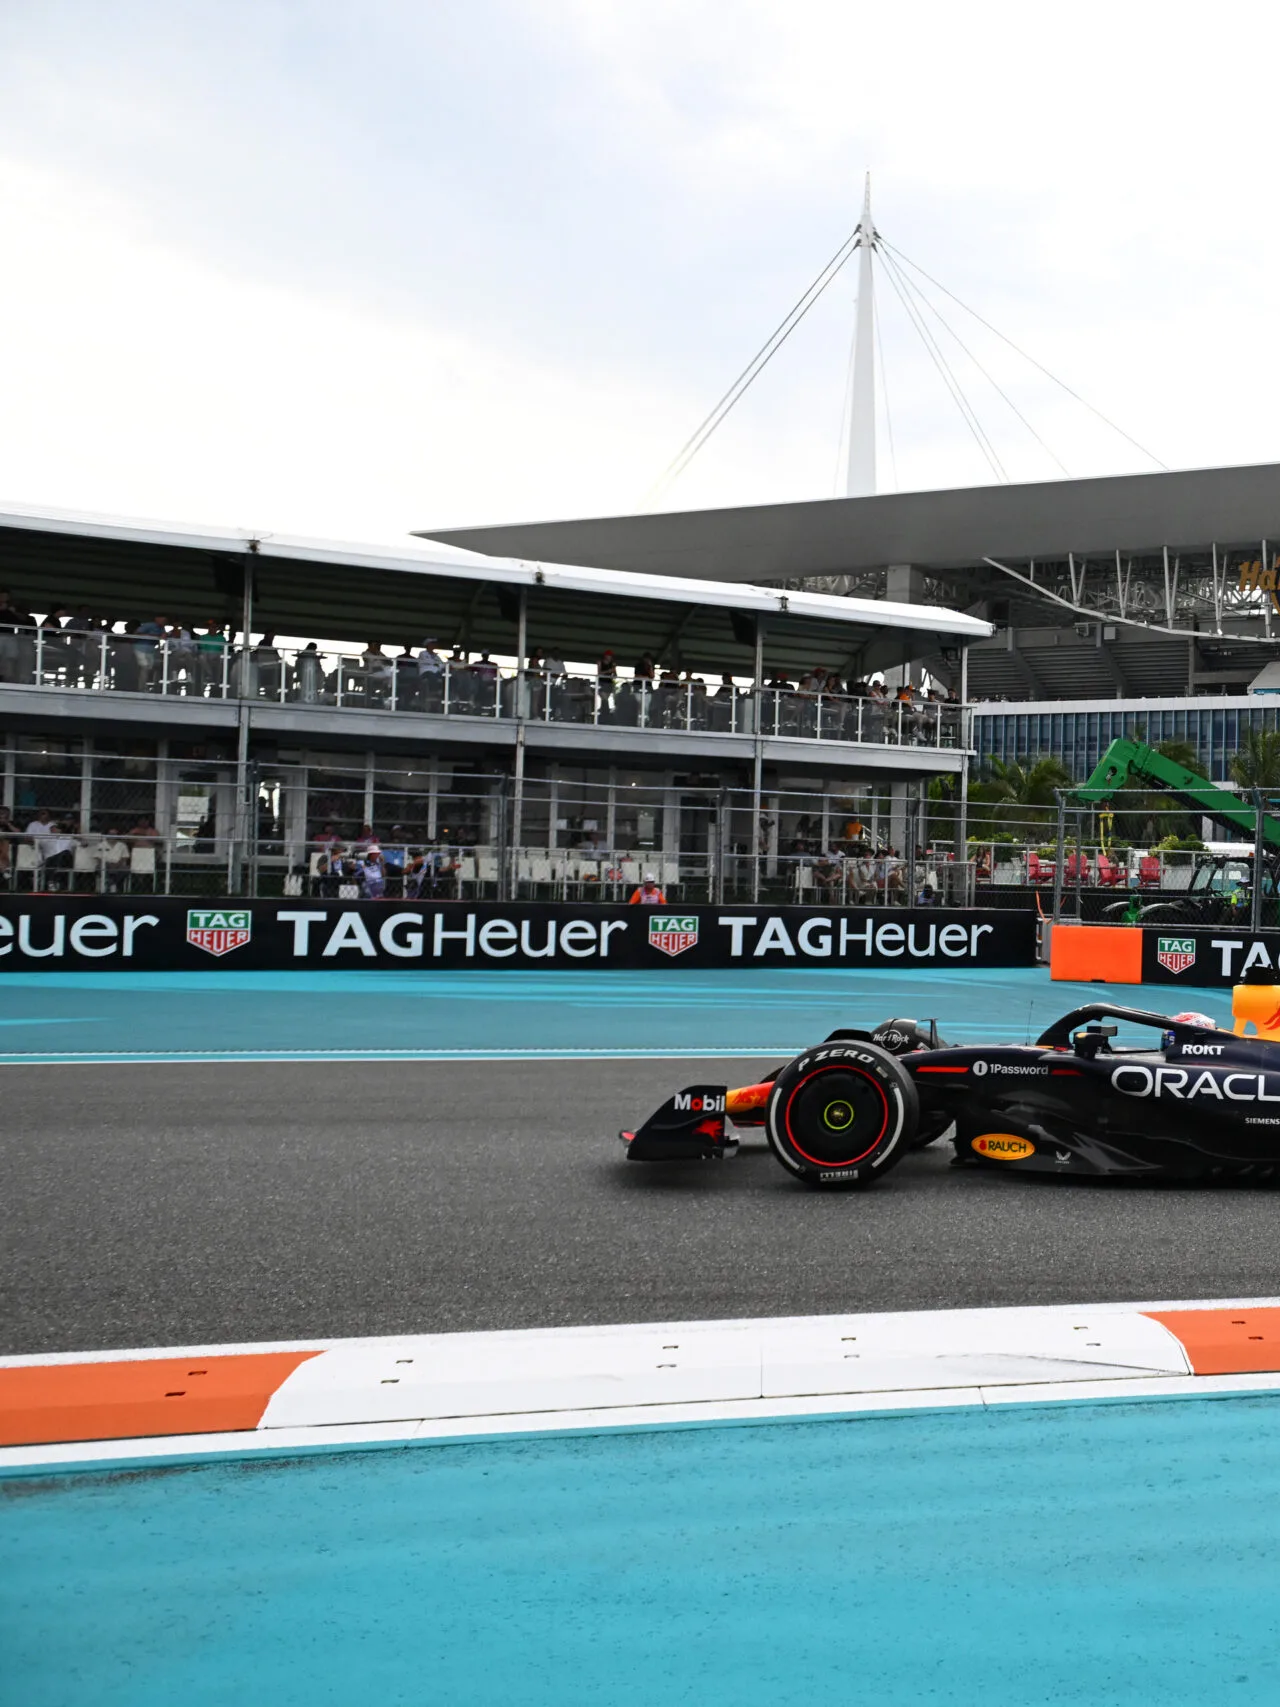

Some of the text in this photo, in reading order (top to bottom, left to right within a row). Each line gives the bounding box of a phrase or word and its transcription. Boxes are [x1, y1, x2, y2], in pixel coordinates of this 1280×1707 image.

[193, 912, 246, 928] TAG
[653, 918, 695, 931] TAG
[190, 929, 248, 956] HEUER
[651, 933, 695, 953] HEUER
[1160, 940, 1192, 952] TAG
[1159, 953, 1194, 971] HEUER
[1181, 1044, 1226, 1056] ROKT
[798, 1048, 875, 1072] P ZERO
[989, 1062, 1049, 1077] 1Password
[673, 1093, 726, 1112] Mobil
[1245, 1117, 1280, 1125] SIEMENS
[988, 1140, 1027, 1153] RAUCH
